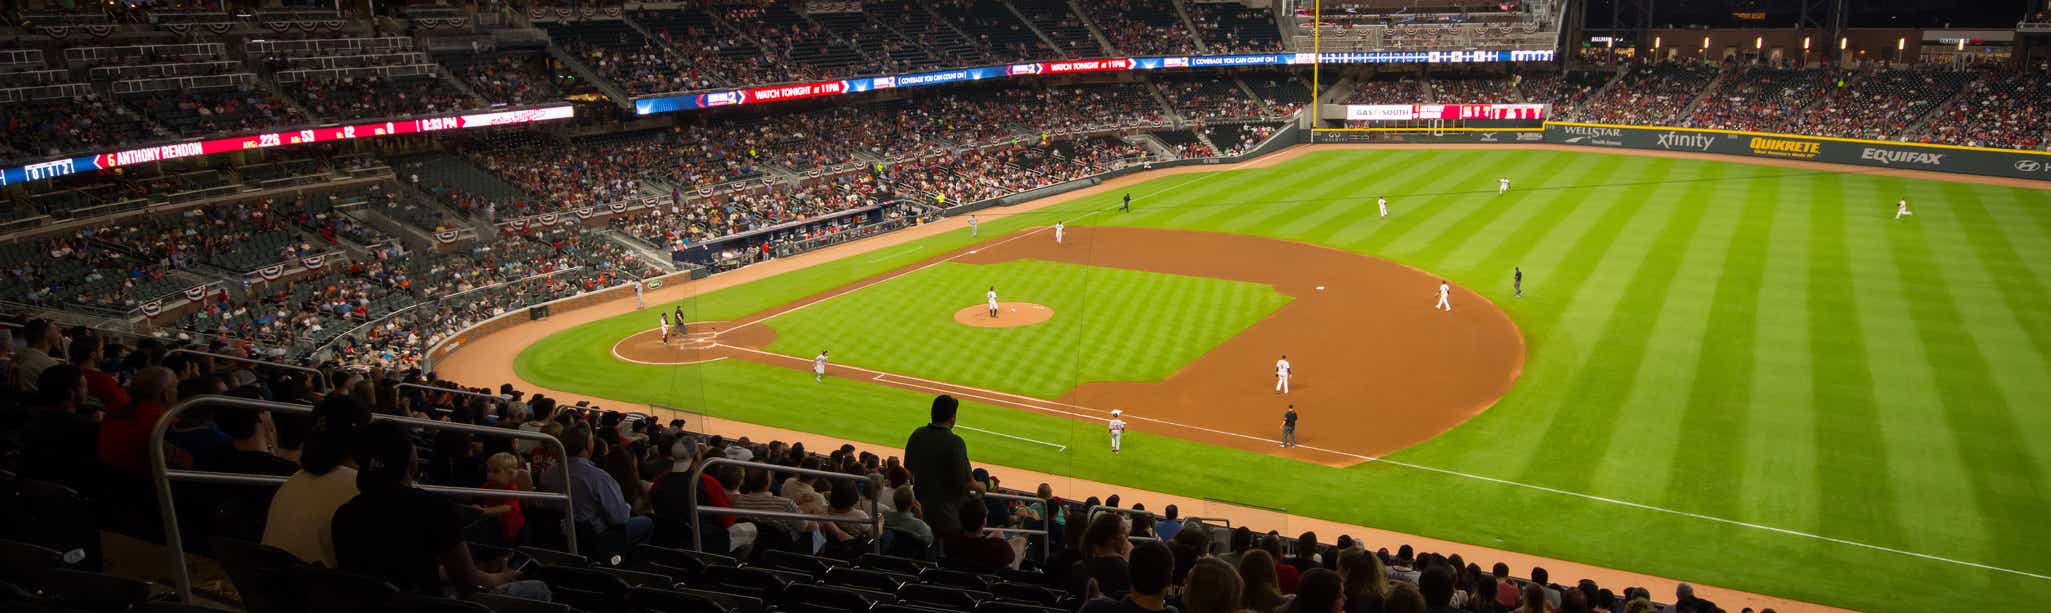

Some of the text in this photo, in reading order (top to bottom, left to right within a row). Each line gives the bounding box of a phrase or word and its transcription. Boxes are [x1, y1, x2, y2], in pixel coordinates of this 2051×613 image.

[1051, 63, 1072, 71] WATCH
[1073, 61, 1099, 70] TONIGHT
[1108, 60, 1126, 68] 11PM
[1196, 57, 1222, 65] COVERAGE
[901, 75, 923, 84] COVERAGE
[943, 72, 956, 80] COUNT
[755, 89, 780, 100] WATCH
[781, 87, 811, 98] TONIGHT
[821, 83, 839, 93] 11PM
[386, 122, 394, 134] 0
[444, 117, 457, 129] PM
[301, 129, 315, 142] 53
[344, 126, 355, 138] 12
[1564, 126, 1622, 137] WELLSTAR
[258, 133, 281, 147] .226
[1657, 131, 1715, 151] xfinity
[1750, 137, 1820, 153] QUIKRETE
[108, 142, 203, 167] 6 ANTHONY RENDON
[1861, 147, 1944, 165] EQUIFAX
